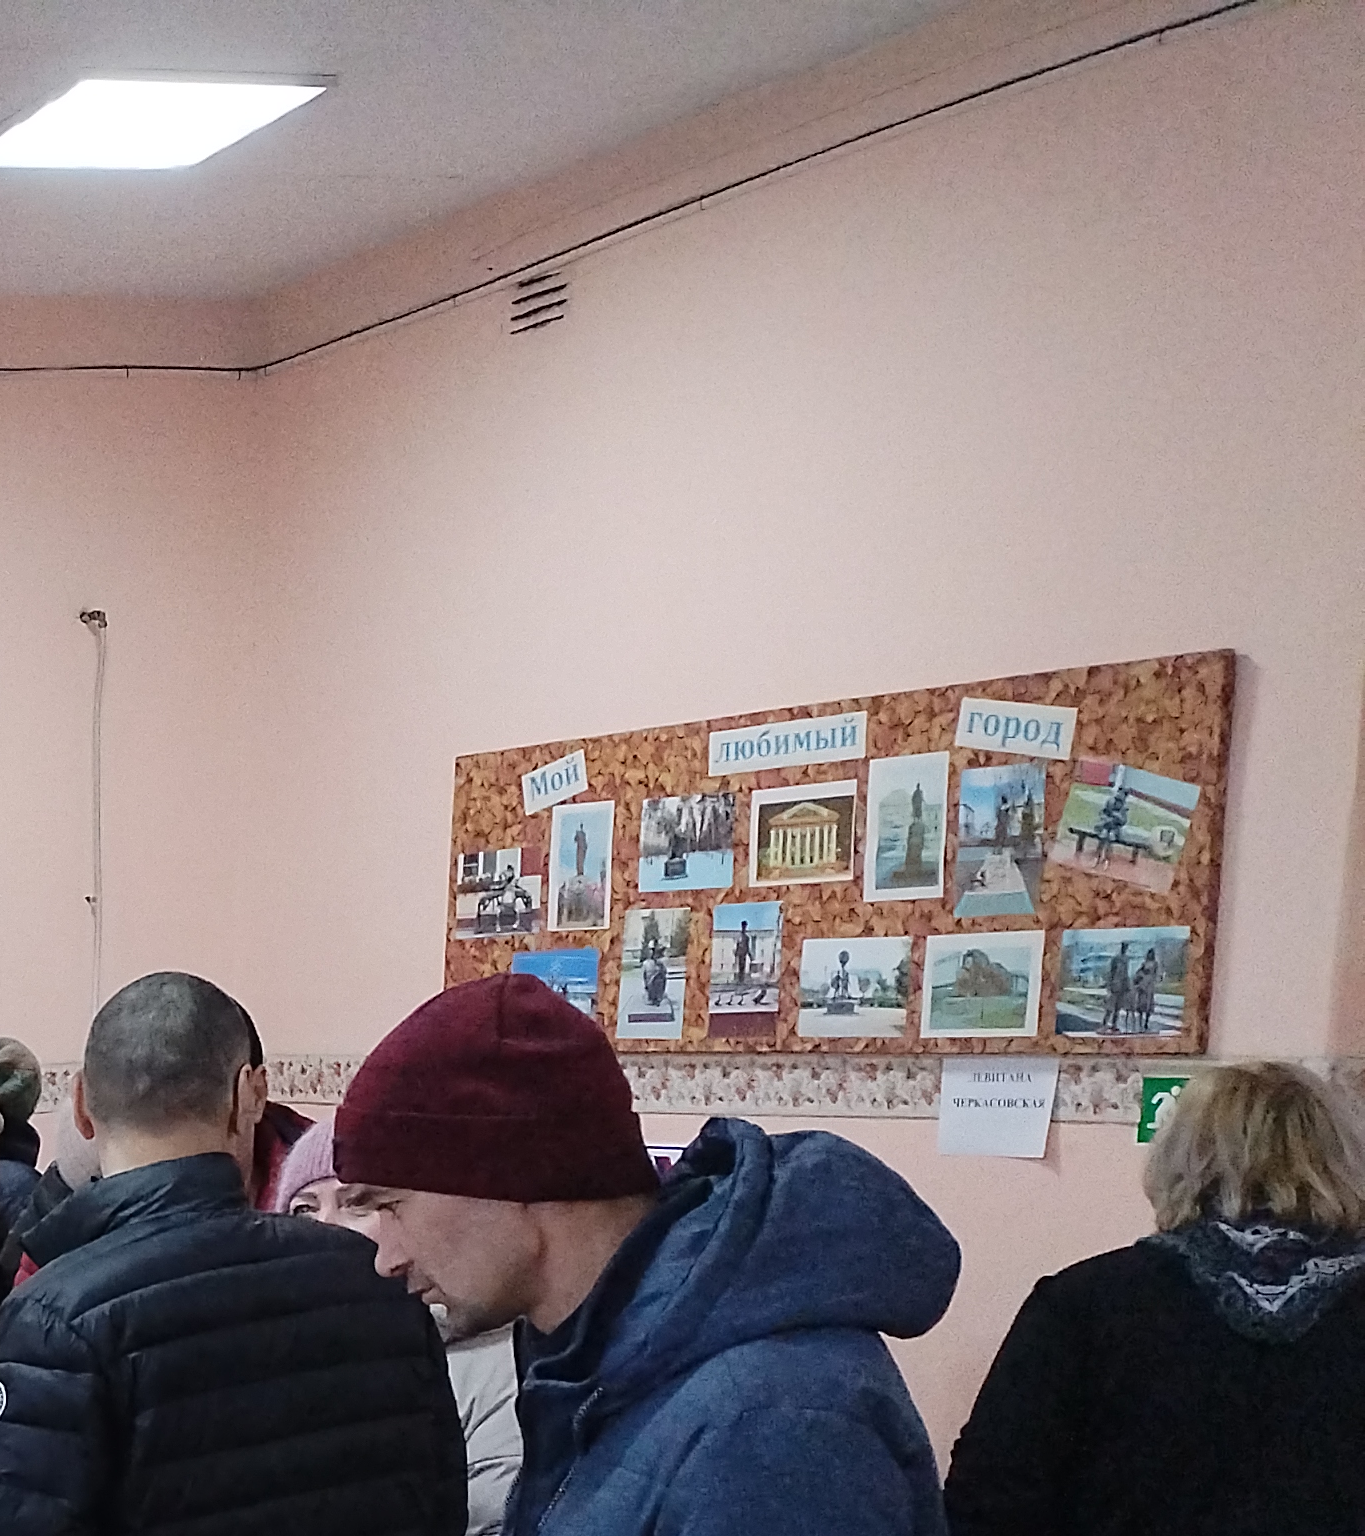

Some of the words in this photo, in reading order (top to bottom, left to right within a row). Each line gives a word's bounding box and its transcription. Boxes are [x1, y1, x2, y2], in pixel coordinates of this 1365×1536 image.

[530, 756, 580, 801] Мой
[714, 717, 858, 763] любимый
[967, 712, 1063, 752] город
[953, 1097, 1046, 1108] ЧЕРКАСОВСКАЯ
